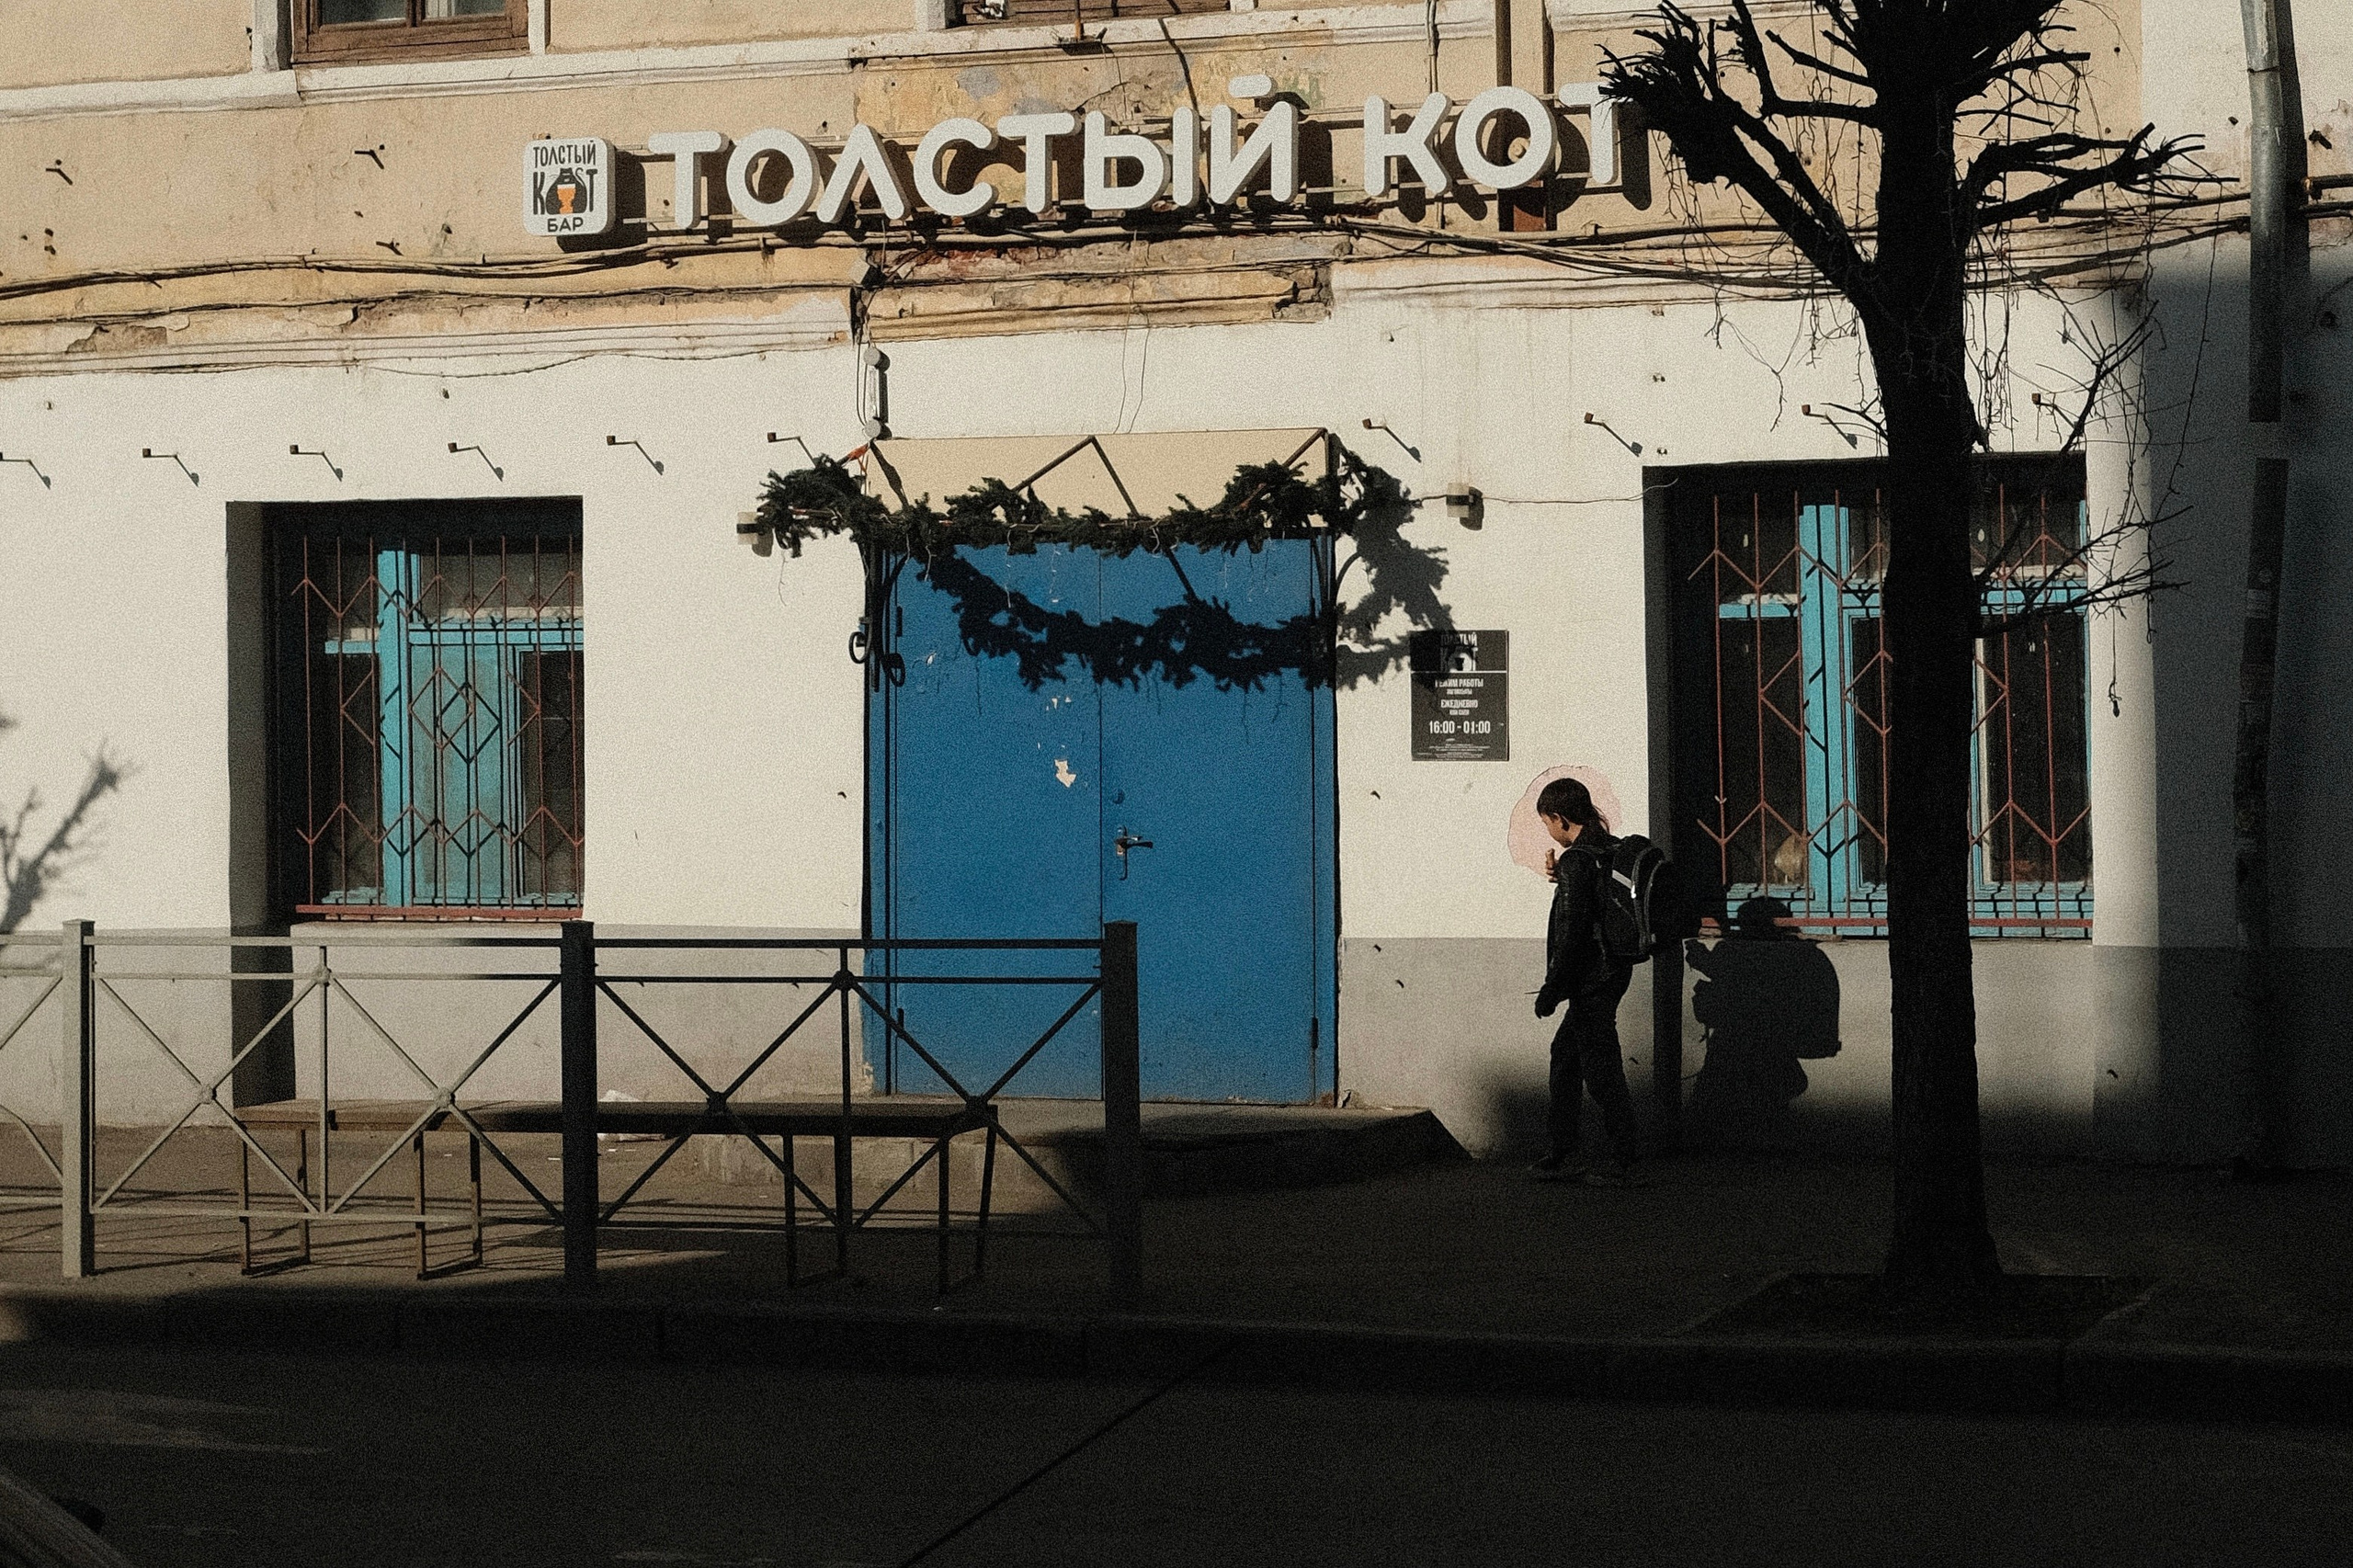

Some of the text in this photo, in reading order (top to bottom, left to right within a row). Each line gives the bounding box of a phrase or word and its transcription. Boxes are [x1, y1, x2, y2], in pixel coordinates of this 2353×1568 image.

[533, 140, 597, 168] ТОЛСТЫЙ
[648, 74, 1631, 230] ТОЛСТЫЙ КОТ
[547, 217, 584, 233] БАР
[1459, 678, 1484, 687] РАБОТЫ
[1428, 720, 1455, 734] 16:00
[1462, 720, 1491, 734] 01:00
